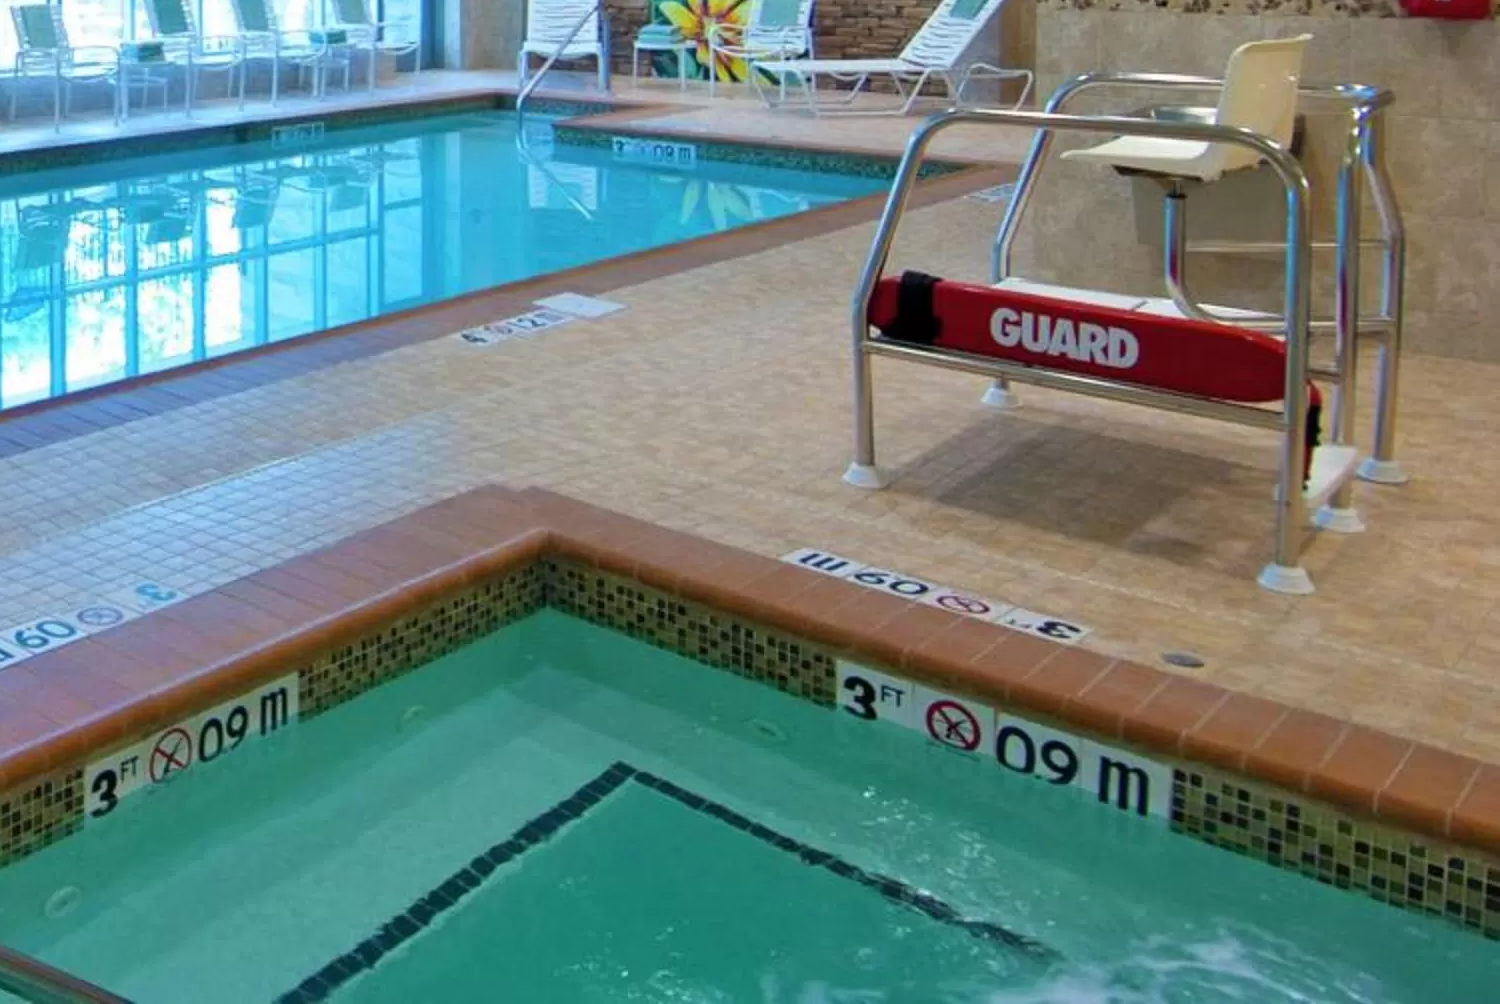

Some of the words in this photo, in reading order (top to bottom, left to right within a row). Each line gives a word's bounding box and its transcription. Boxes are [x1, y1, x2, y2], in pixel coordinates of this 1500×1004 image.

[989, 307, 1139, 369] GUARD
[799, 553, 847, 571] m
[135, 582, 178, 602] 3
[1036, 620, 1081, 639] 3
[91, 769, 118, 818] 3
[119, 754, 140, 781] FT
[259, 687, 288, 737] m
[844, 676, 877, 721] 3
[881, 684, 904, 708] FT
[1098, 755, 1149, 817] m
